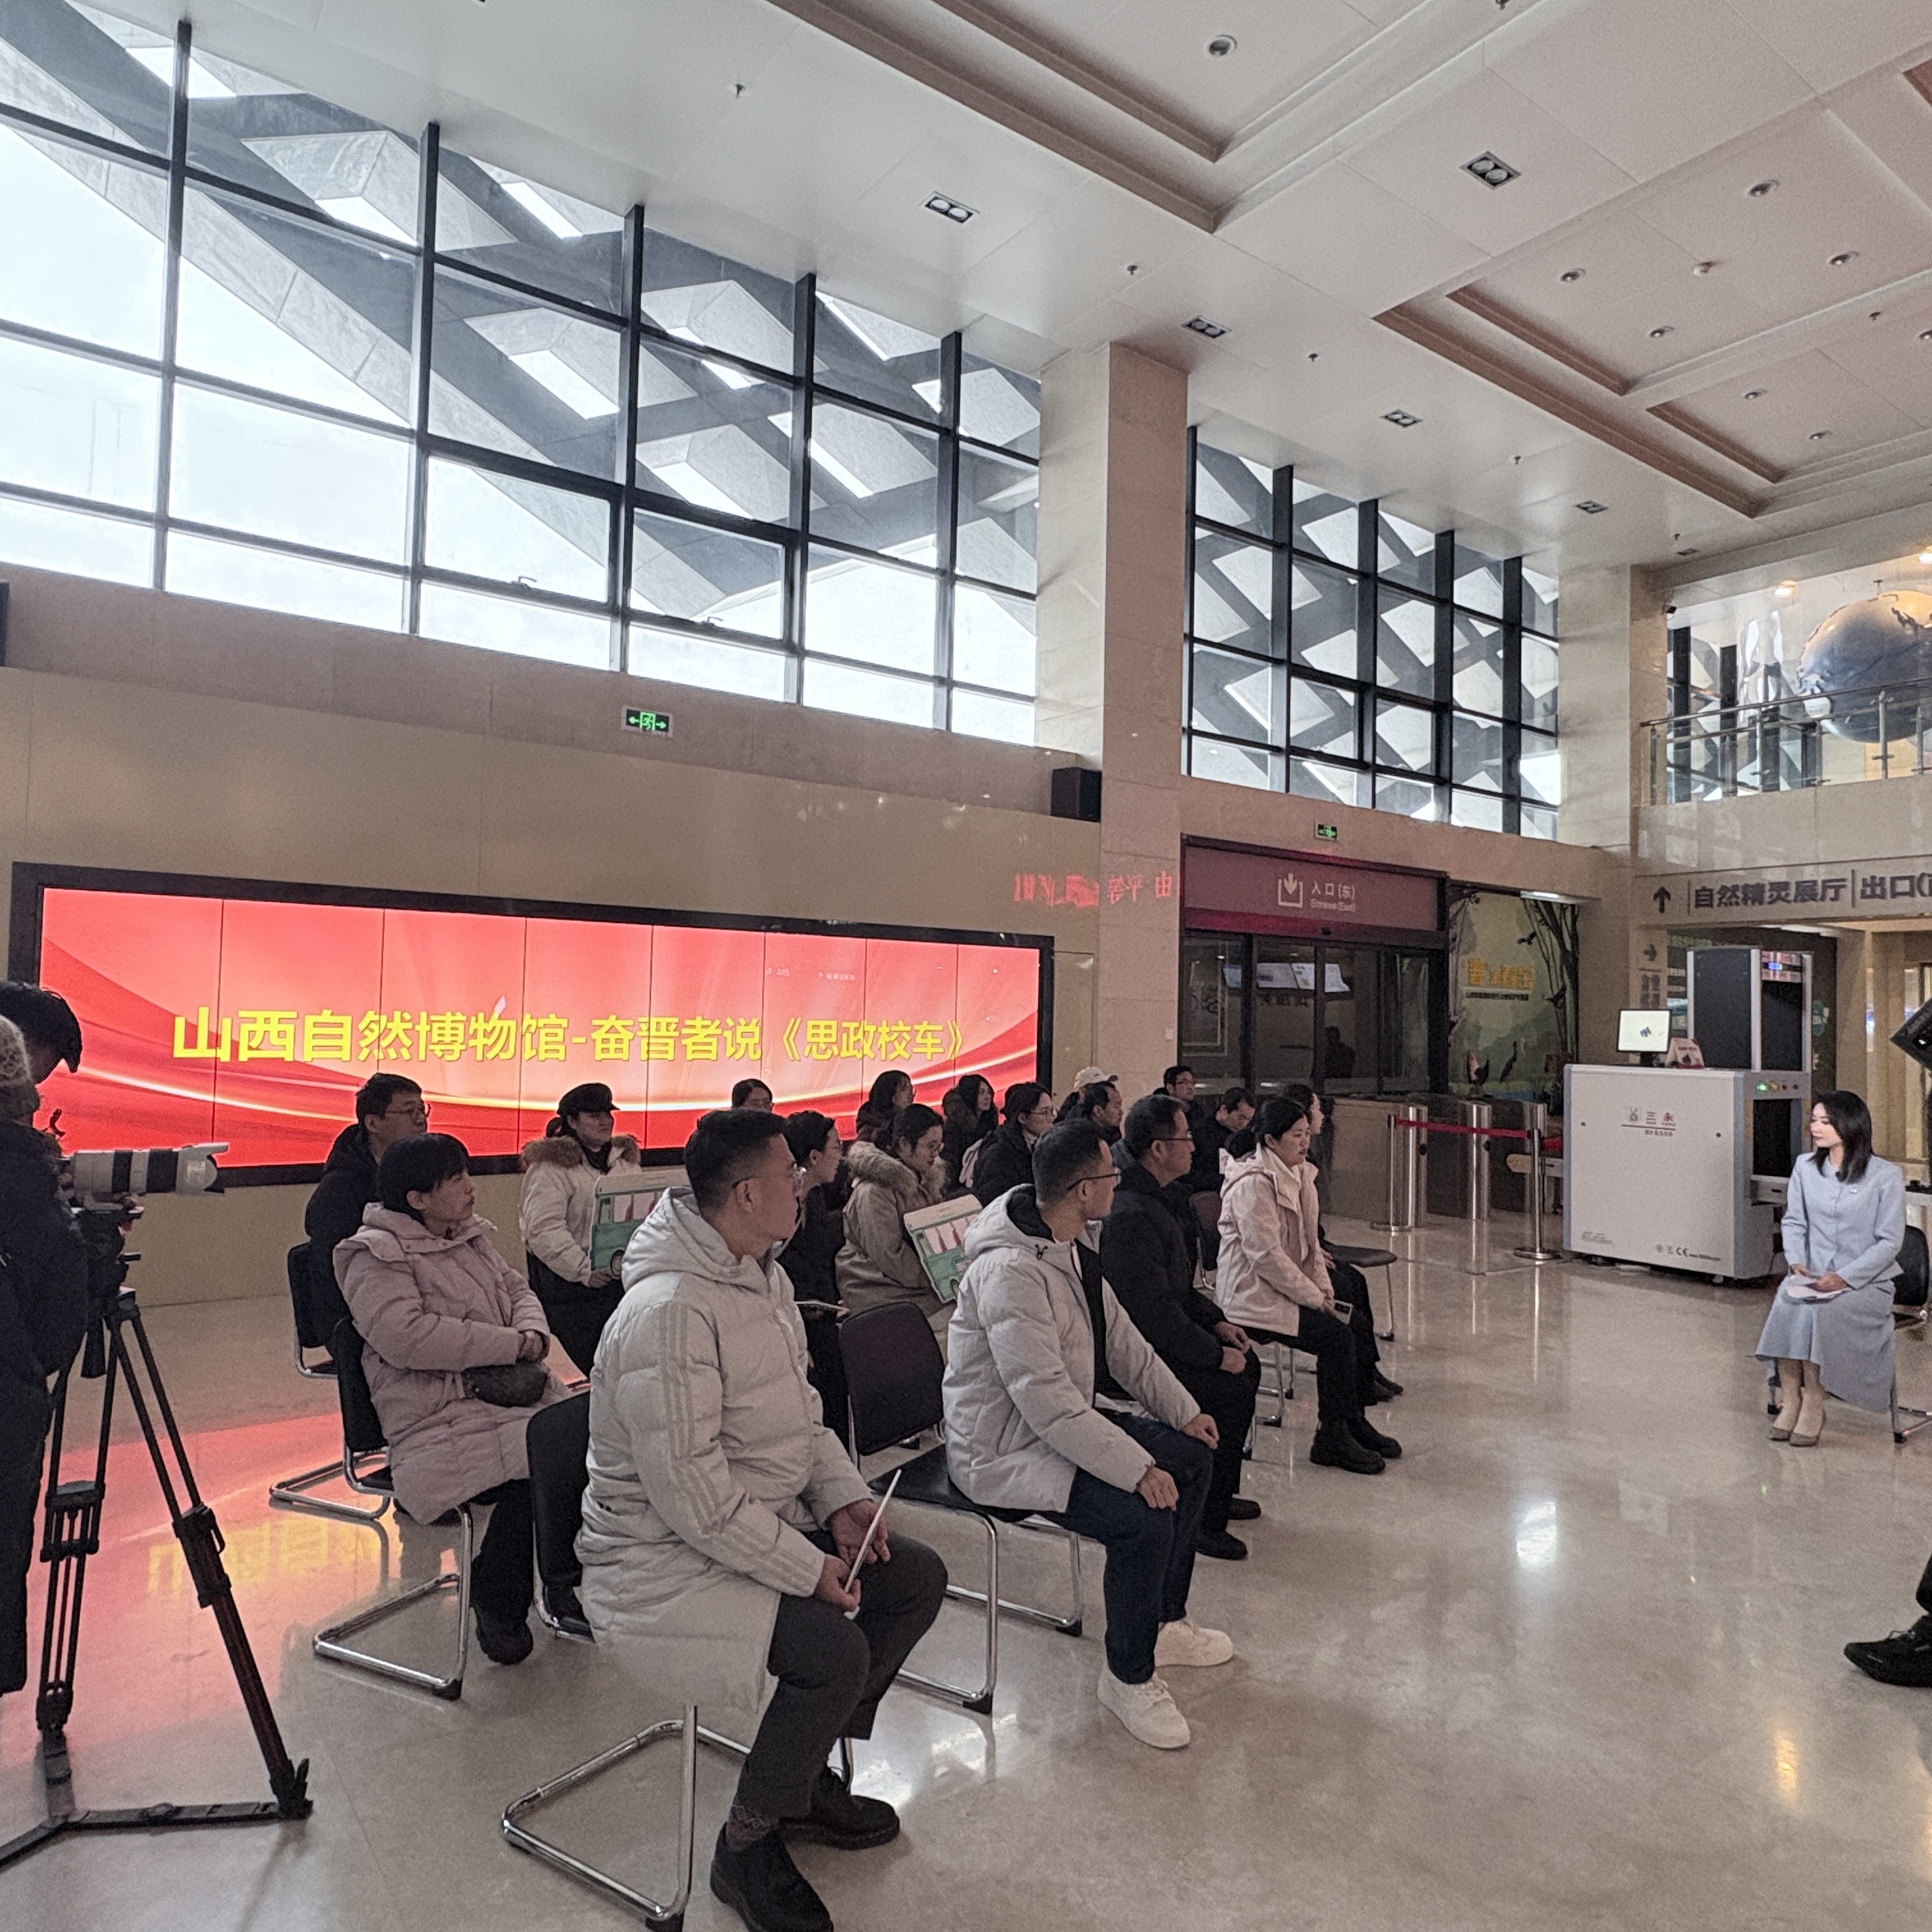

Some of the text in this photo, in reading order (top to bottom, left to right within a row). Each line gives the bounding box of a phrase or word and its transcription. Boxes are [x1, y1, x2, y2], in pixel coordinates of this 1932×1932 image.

[1694, 877, 1847, 908] 自然精灵展厅
[1860, 871, 1932, 900] 出口(
[173, 1006, 963, 1062] 山西自然博物馆-奋晋者说《思政校车》
